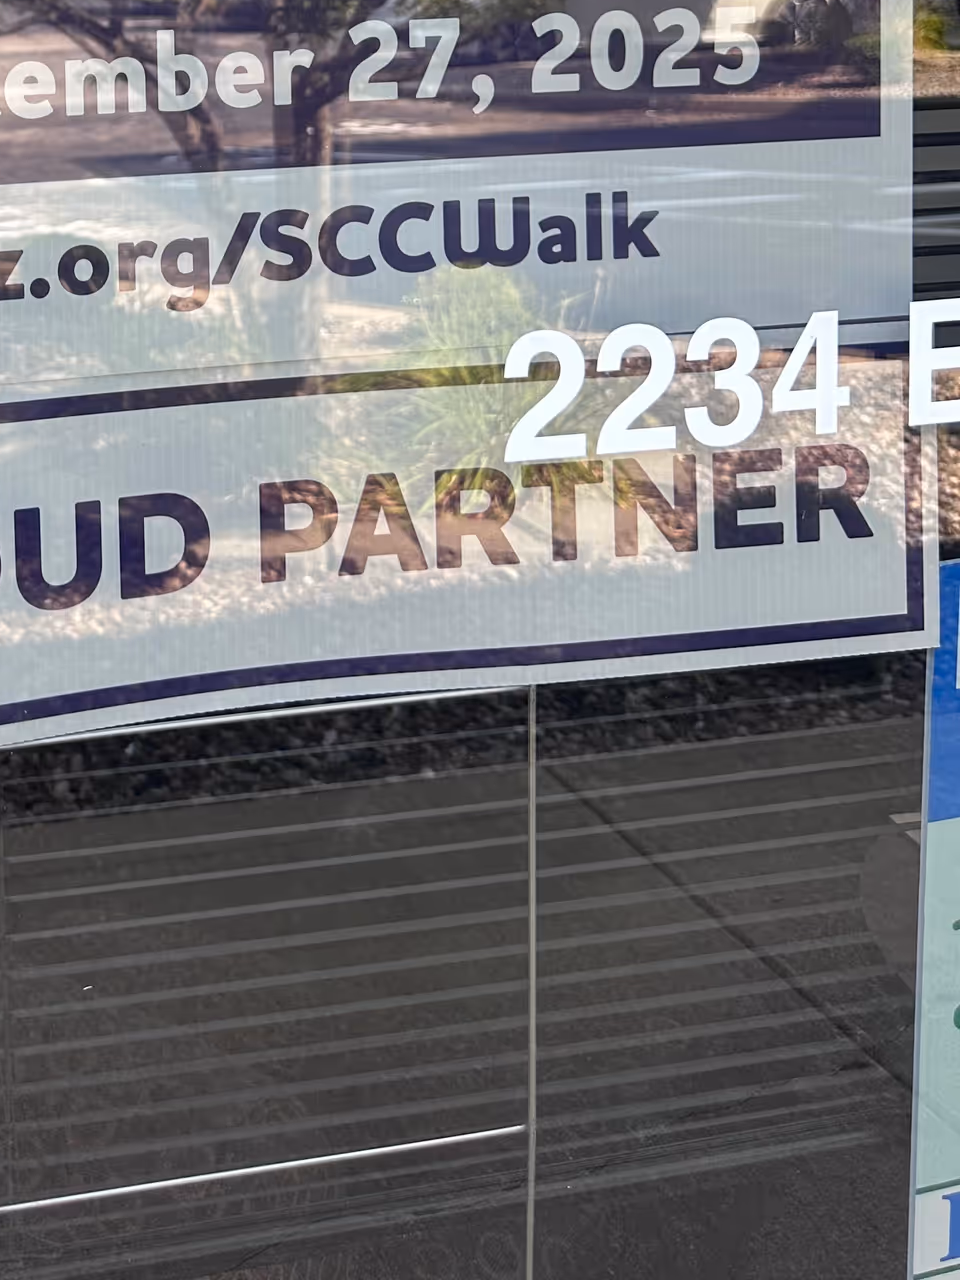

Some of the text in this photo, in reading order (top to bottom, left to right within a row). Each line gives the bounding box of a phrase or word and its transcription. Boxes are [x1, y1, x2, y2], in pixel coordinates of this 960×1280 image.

[348, 17, 496, 115] 27,
[531, 6, 761, 94] 2025
[503, 310, 851, 464] 2234
[258, 442, 875, 583] PARTNER
